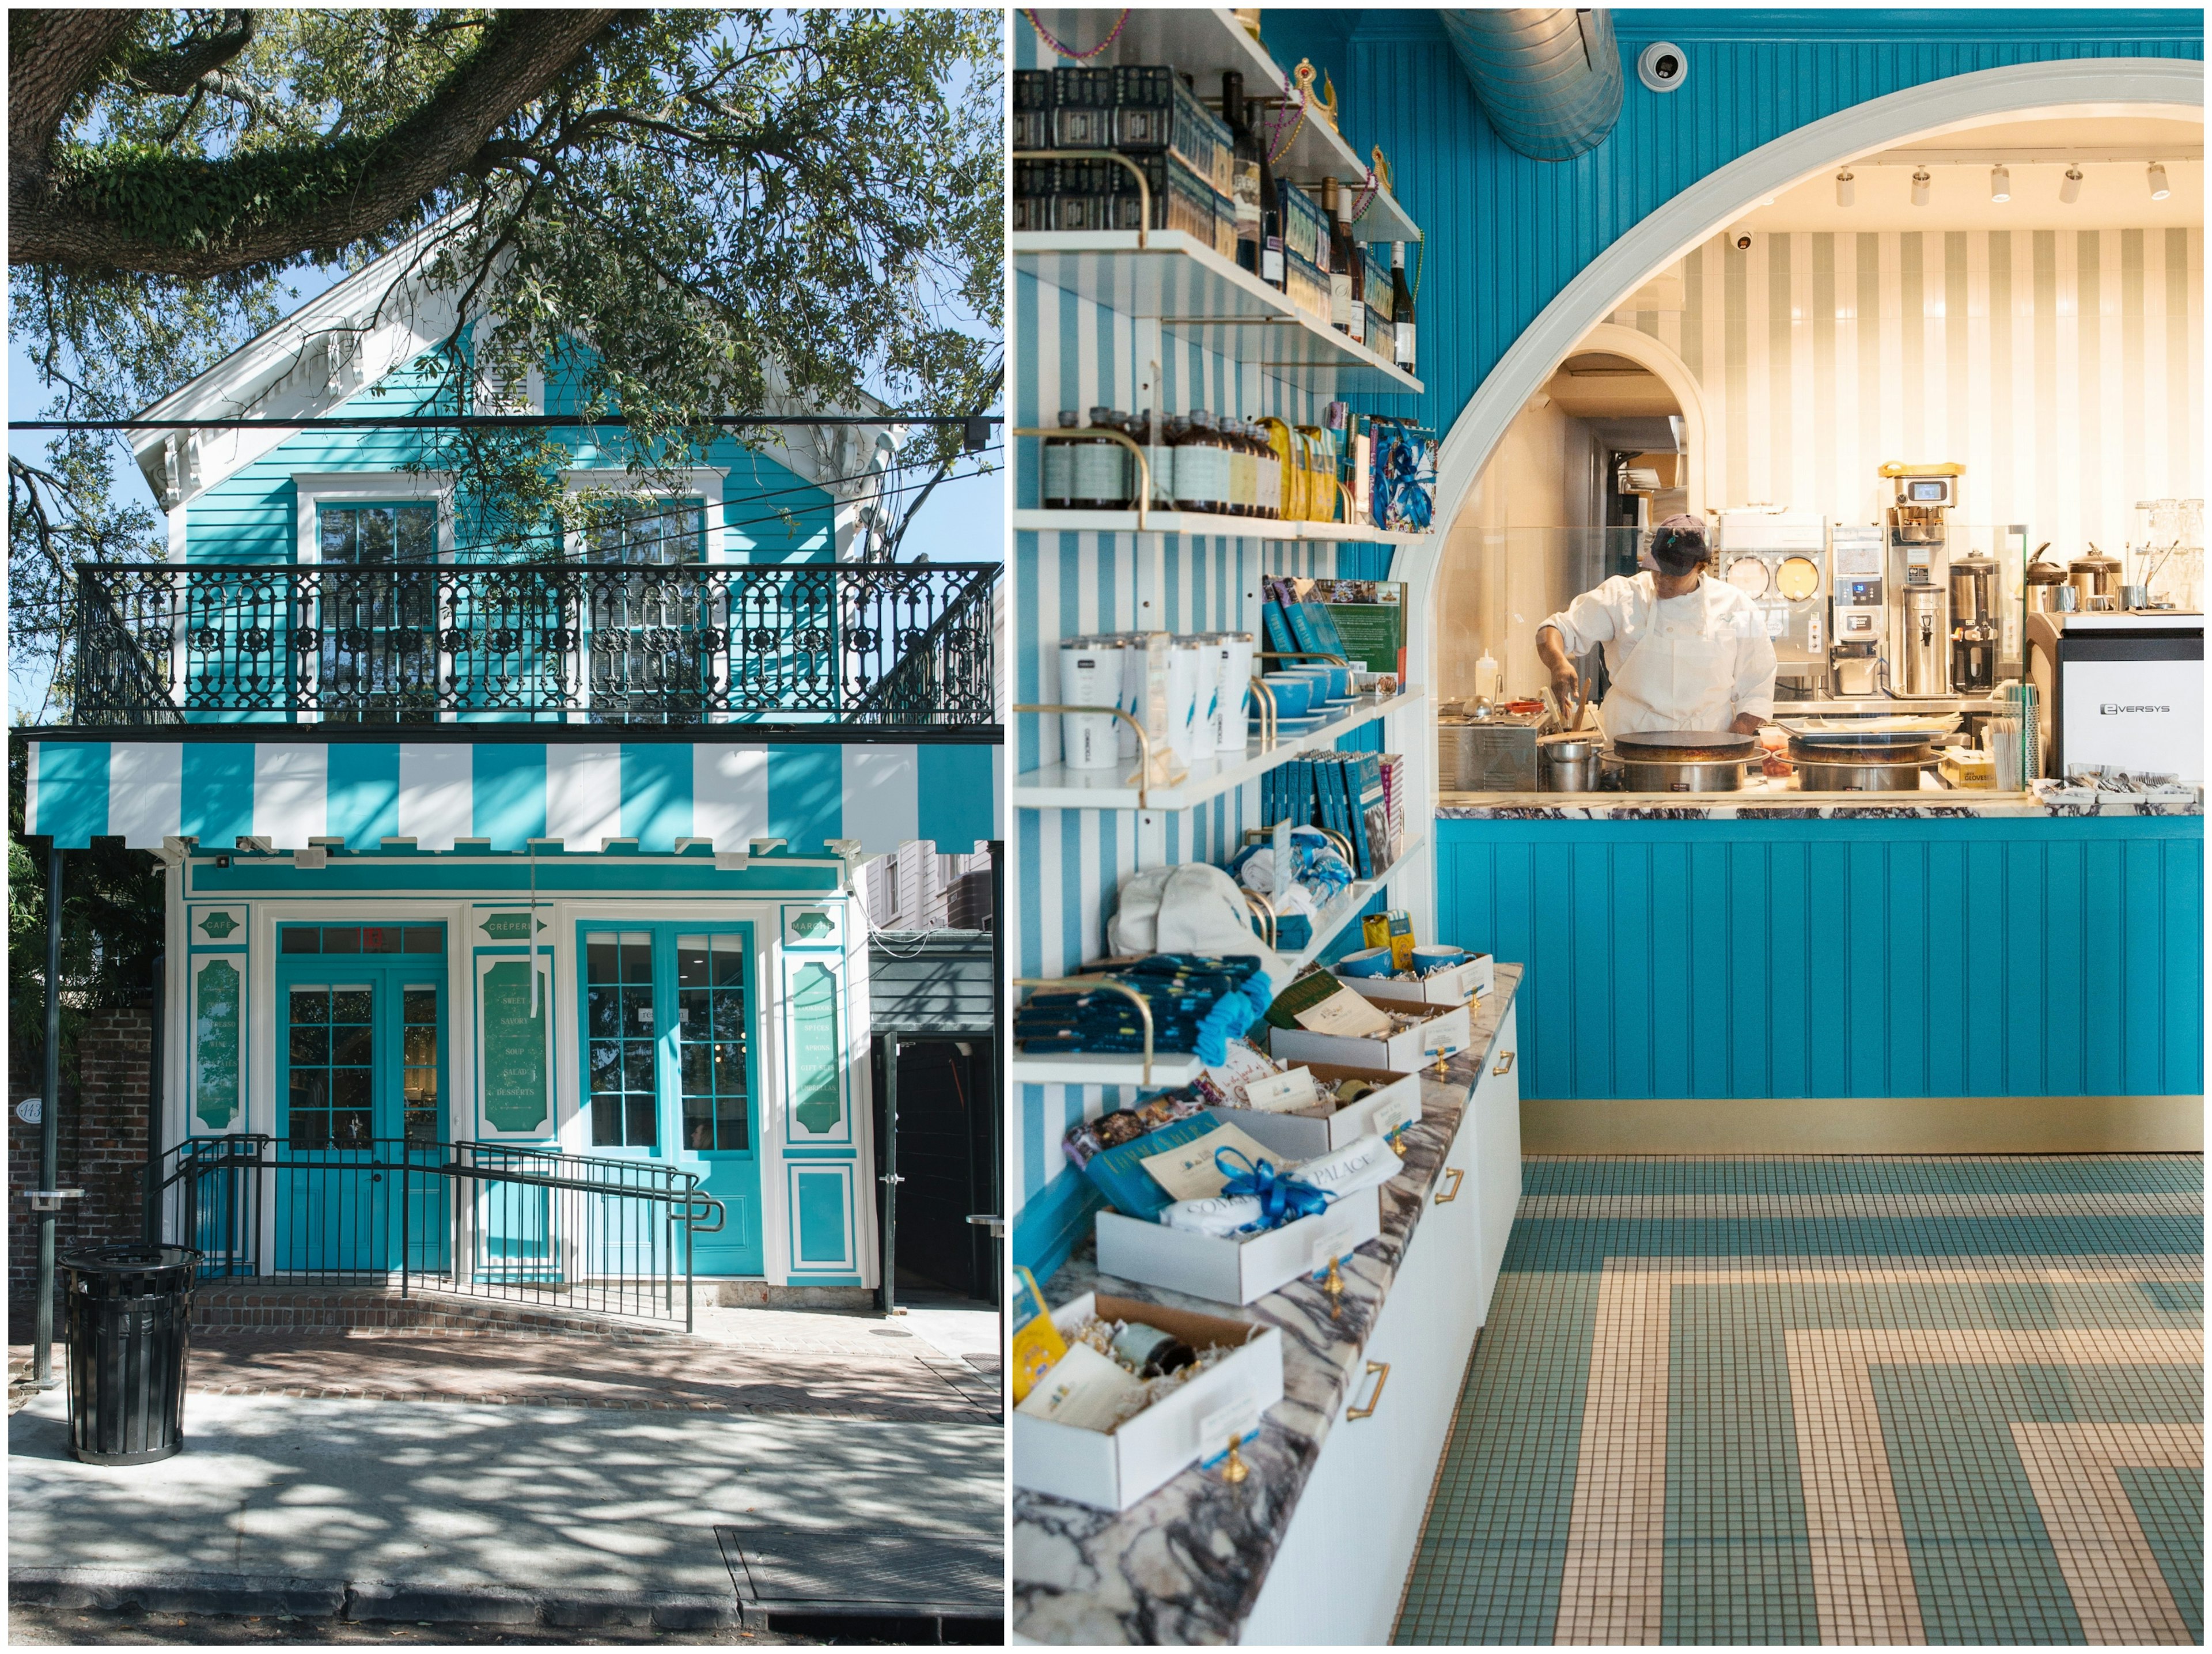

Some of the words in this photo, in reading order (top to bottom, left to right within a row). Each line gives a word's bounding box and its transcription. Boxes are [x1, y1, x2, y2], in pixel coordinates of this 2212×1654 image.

[489, 922, 531, 930] CRÊPERI
[24, 1104, 41, 1117] 143
[1313, 1153, 1374, 1186] PALACE
